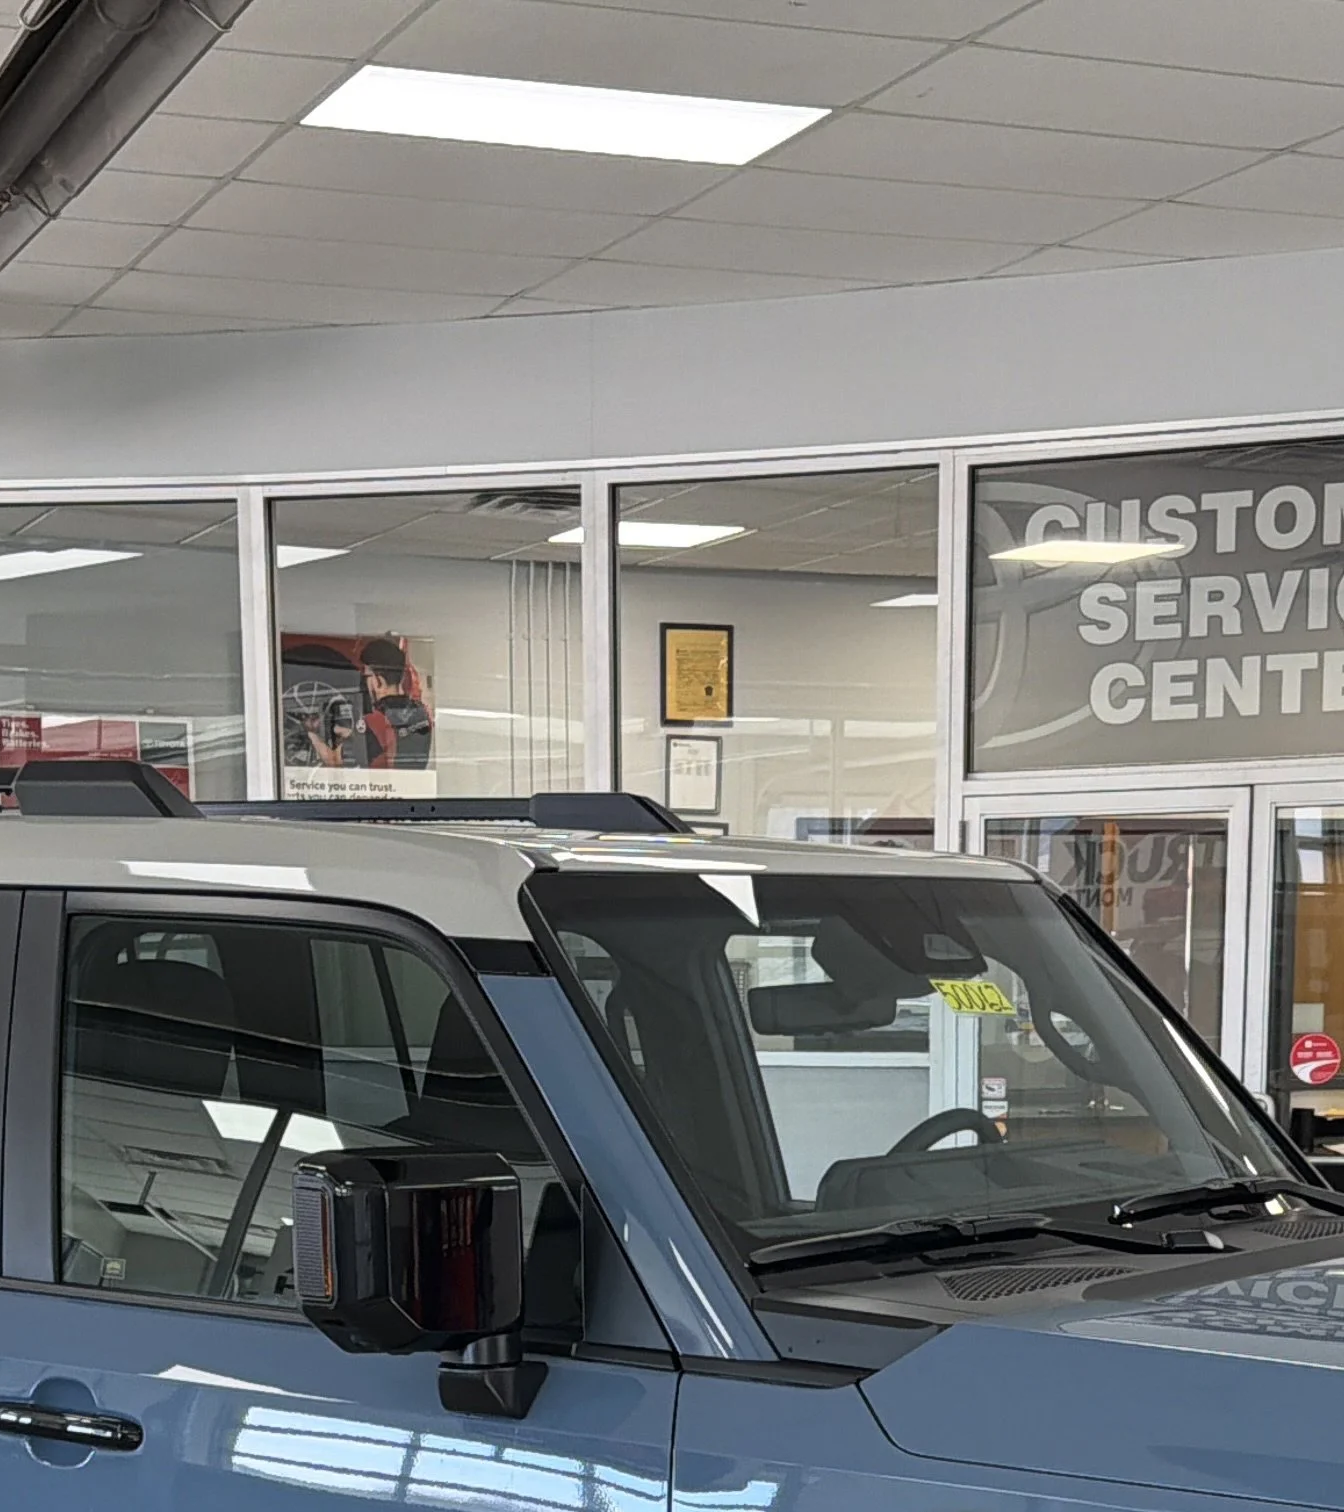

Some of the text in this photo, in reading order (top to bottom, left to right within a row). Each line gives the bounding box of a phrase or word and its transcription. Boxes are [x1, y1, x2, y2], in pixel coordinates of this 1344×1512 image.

[289, 780, 396, 792] Service you can trust.
